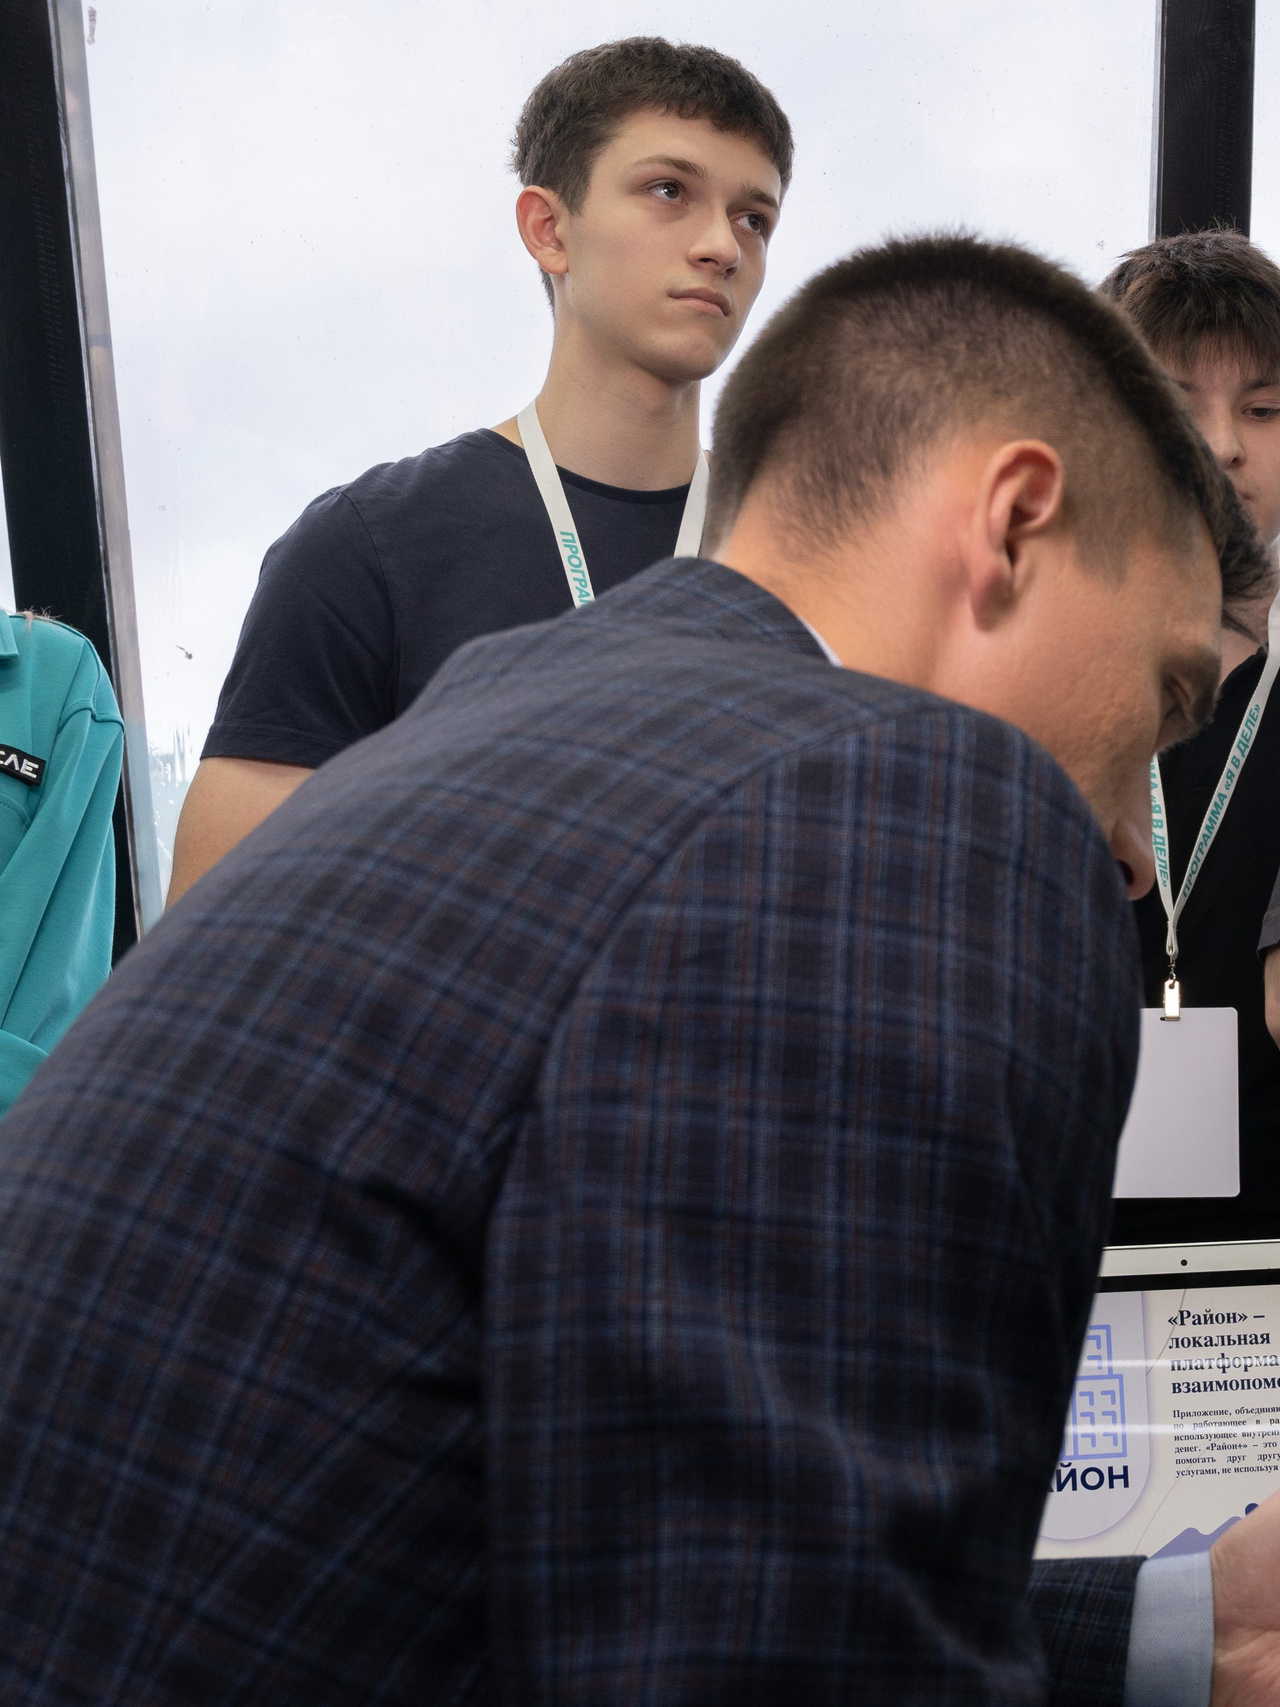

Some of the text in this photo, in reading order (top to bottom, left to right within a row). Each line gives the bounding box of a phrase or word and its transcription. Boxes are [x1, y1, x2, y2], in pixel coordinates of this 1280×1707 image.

[1182, 792, 1228, 898] ПРОГРАММА
[1231, 756, 1241, 769] В
[1236, 704, 1261, 758] ДЕЛЕ»
[1151, 819, 1164, 830] В
[1152, 831, 1169, 888] ДЕЛЕ»
[1168, 1308, 1248, 1326] «Район»
[1168, 1332, 1271, 1349] локальная
[1170, 1353, 1280, 1374] платформа
[1172, 1408, 1232, 1420] Приложение,
[1193, 1420, 1247, 1430] работающее
[1174, 1432, 1238, 1442] использующее
[1174, 1445, 1201, 1454] денег.
[1175, 1456, 1217, 1465] помогать
[1226, 1454, 1247, 1463] друг
[1048, 1462, 1129, 1493] ЙОН
[1176, 1468, 1221, 1478] услугами,
[1221, 1466, 1232, 1474] не
[1234, 1463, 1279, 1474] используя
